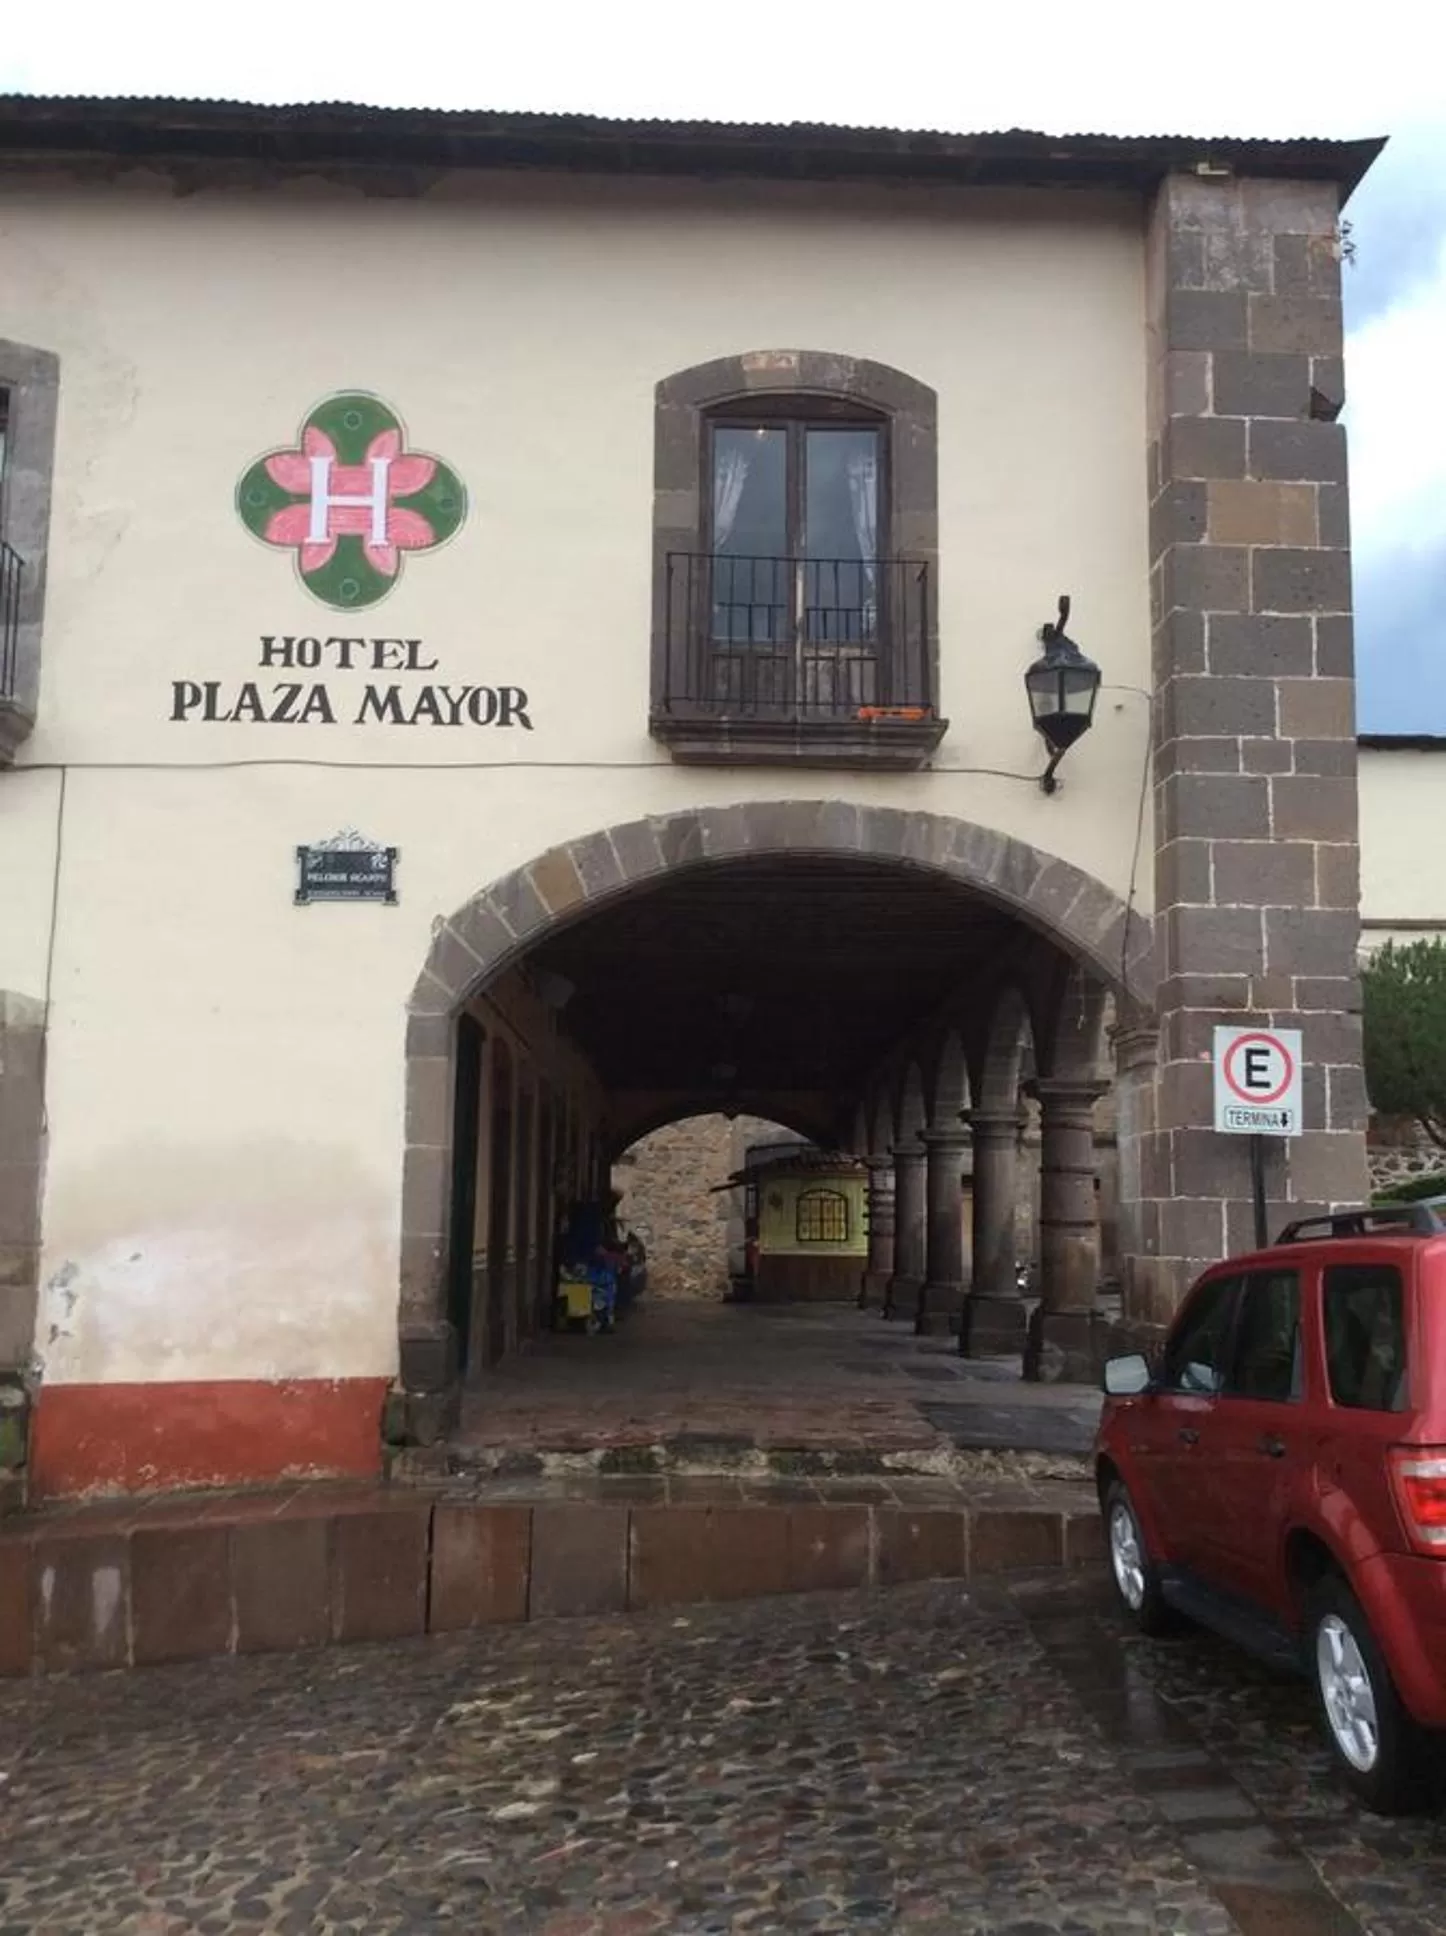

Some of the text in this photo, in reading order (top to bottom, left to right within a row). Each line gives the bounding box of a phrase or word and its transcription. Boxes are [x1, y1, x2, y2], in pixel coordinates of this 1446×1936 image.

[303, 456, 394, 547] H
[258, 636, 439, 670] HOTEL
[170, 680, 534, 730] PLAZA MAYOR
[1245, 1048, 1271, 1088] E
[1229, 1110, 1280, 1126] TERMINA
